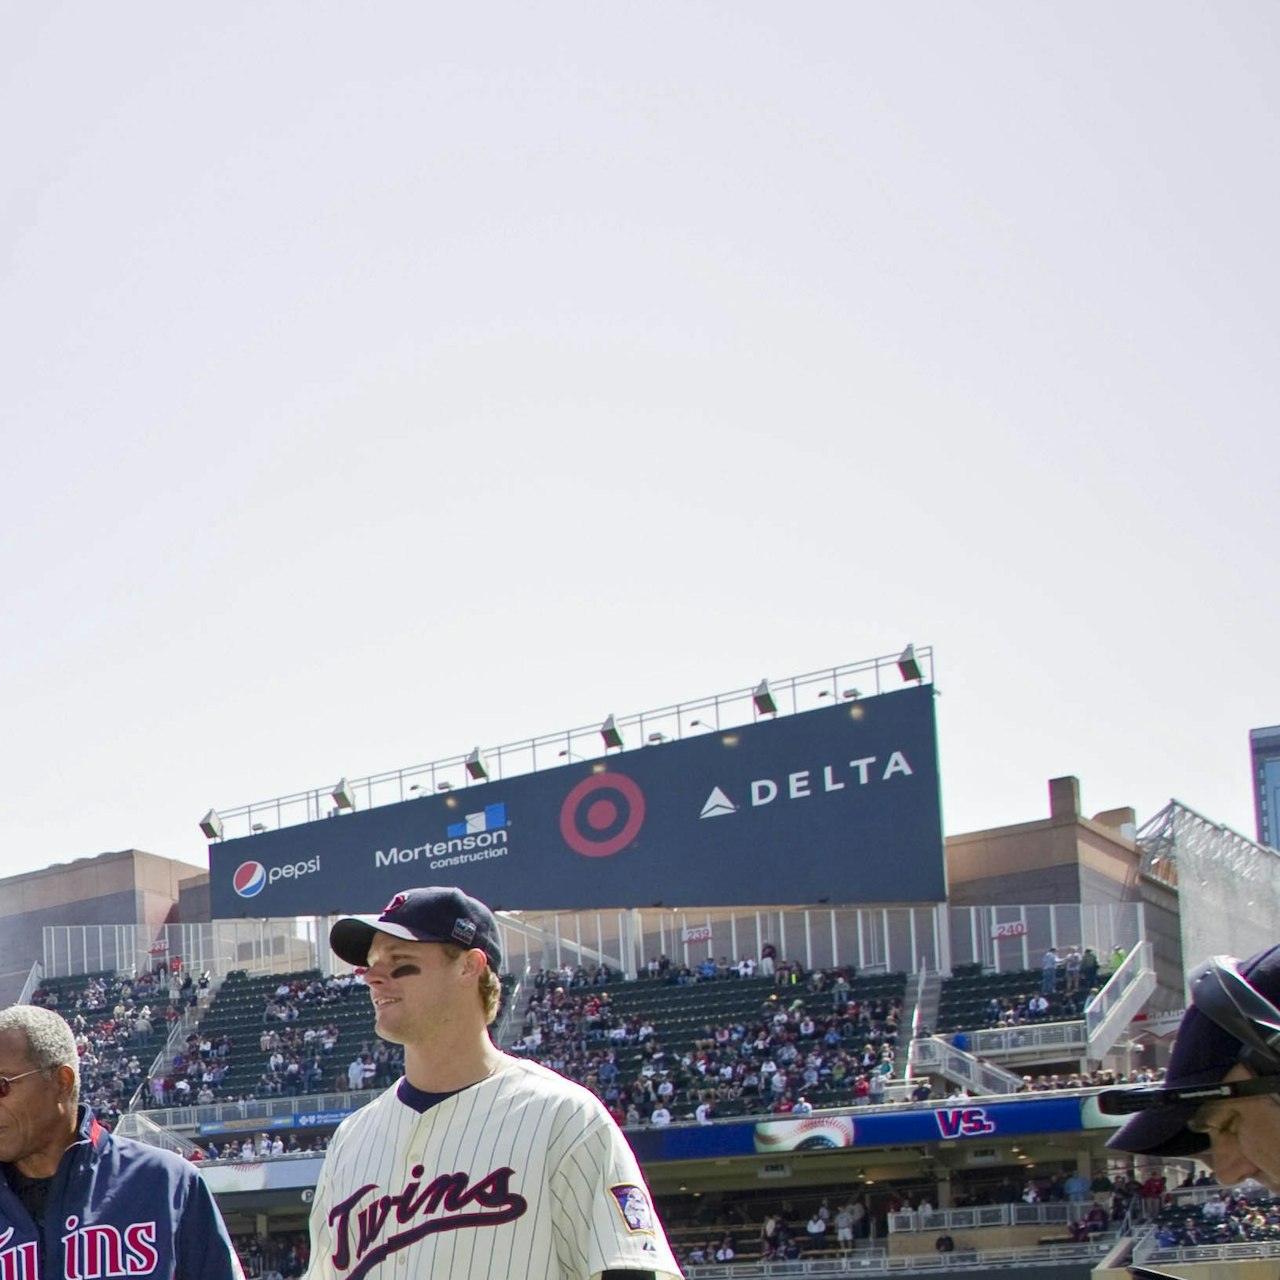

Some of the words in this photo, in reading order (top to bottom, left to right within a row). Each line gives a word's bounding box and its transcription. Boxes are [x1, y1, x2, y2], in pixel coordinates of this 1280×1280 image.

[751, 751, 913, 807] DELTA
[374, 830, 508, 868] Mortenson
[430, 846, 509, 870] construction
[268, 855, 321, 886] pepsi
[934, 1107, 996, 1139] VS.
[329, 1164, 528, 1278] Twins
